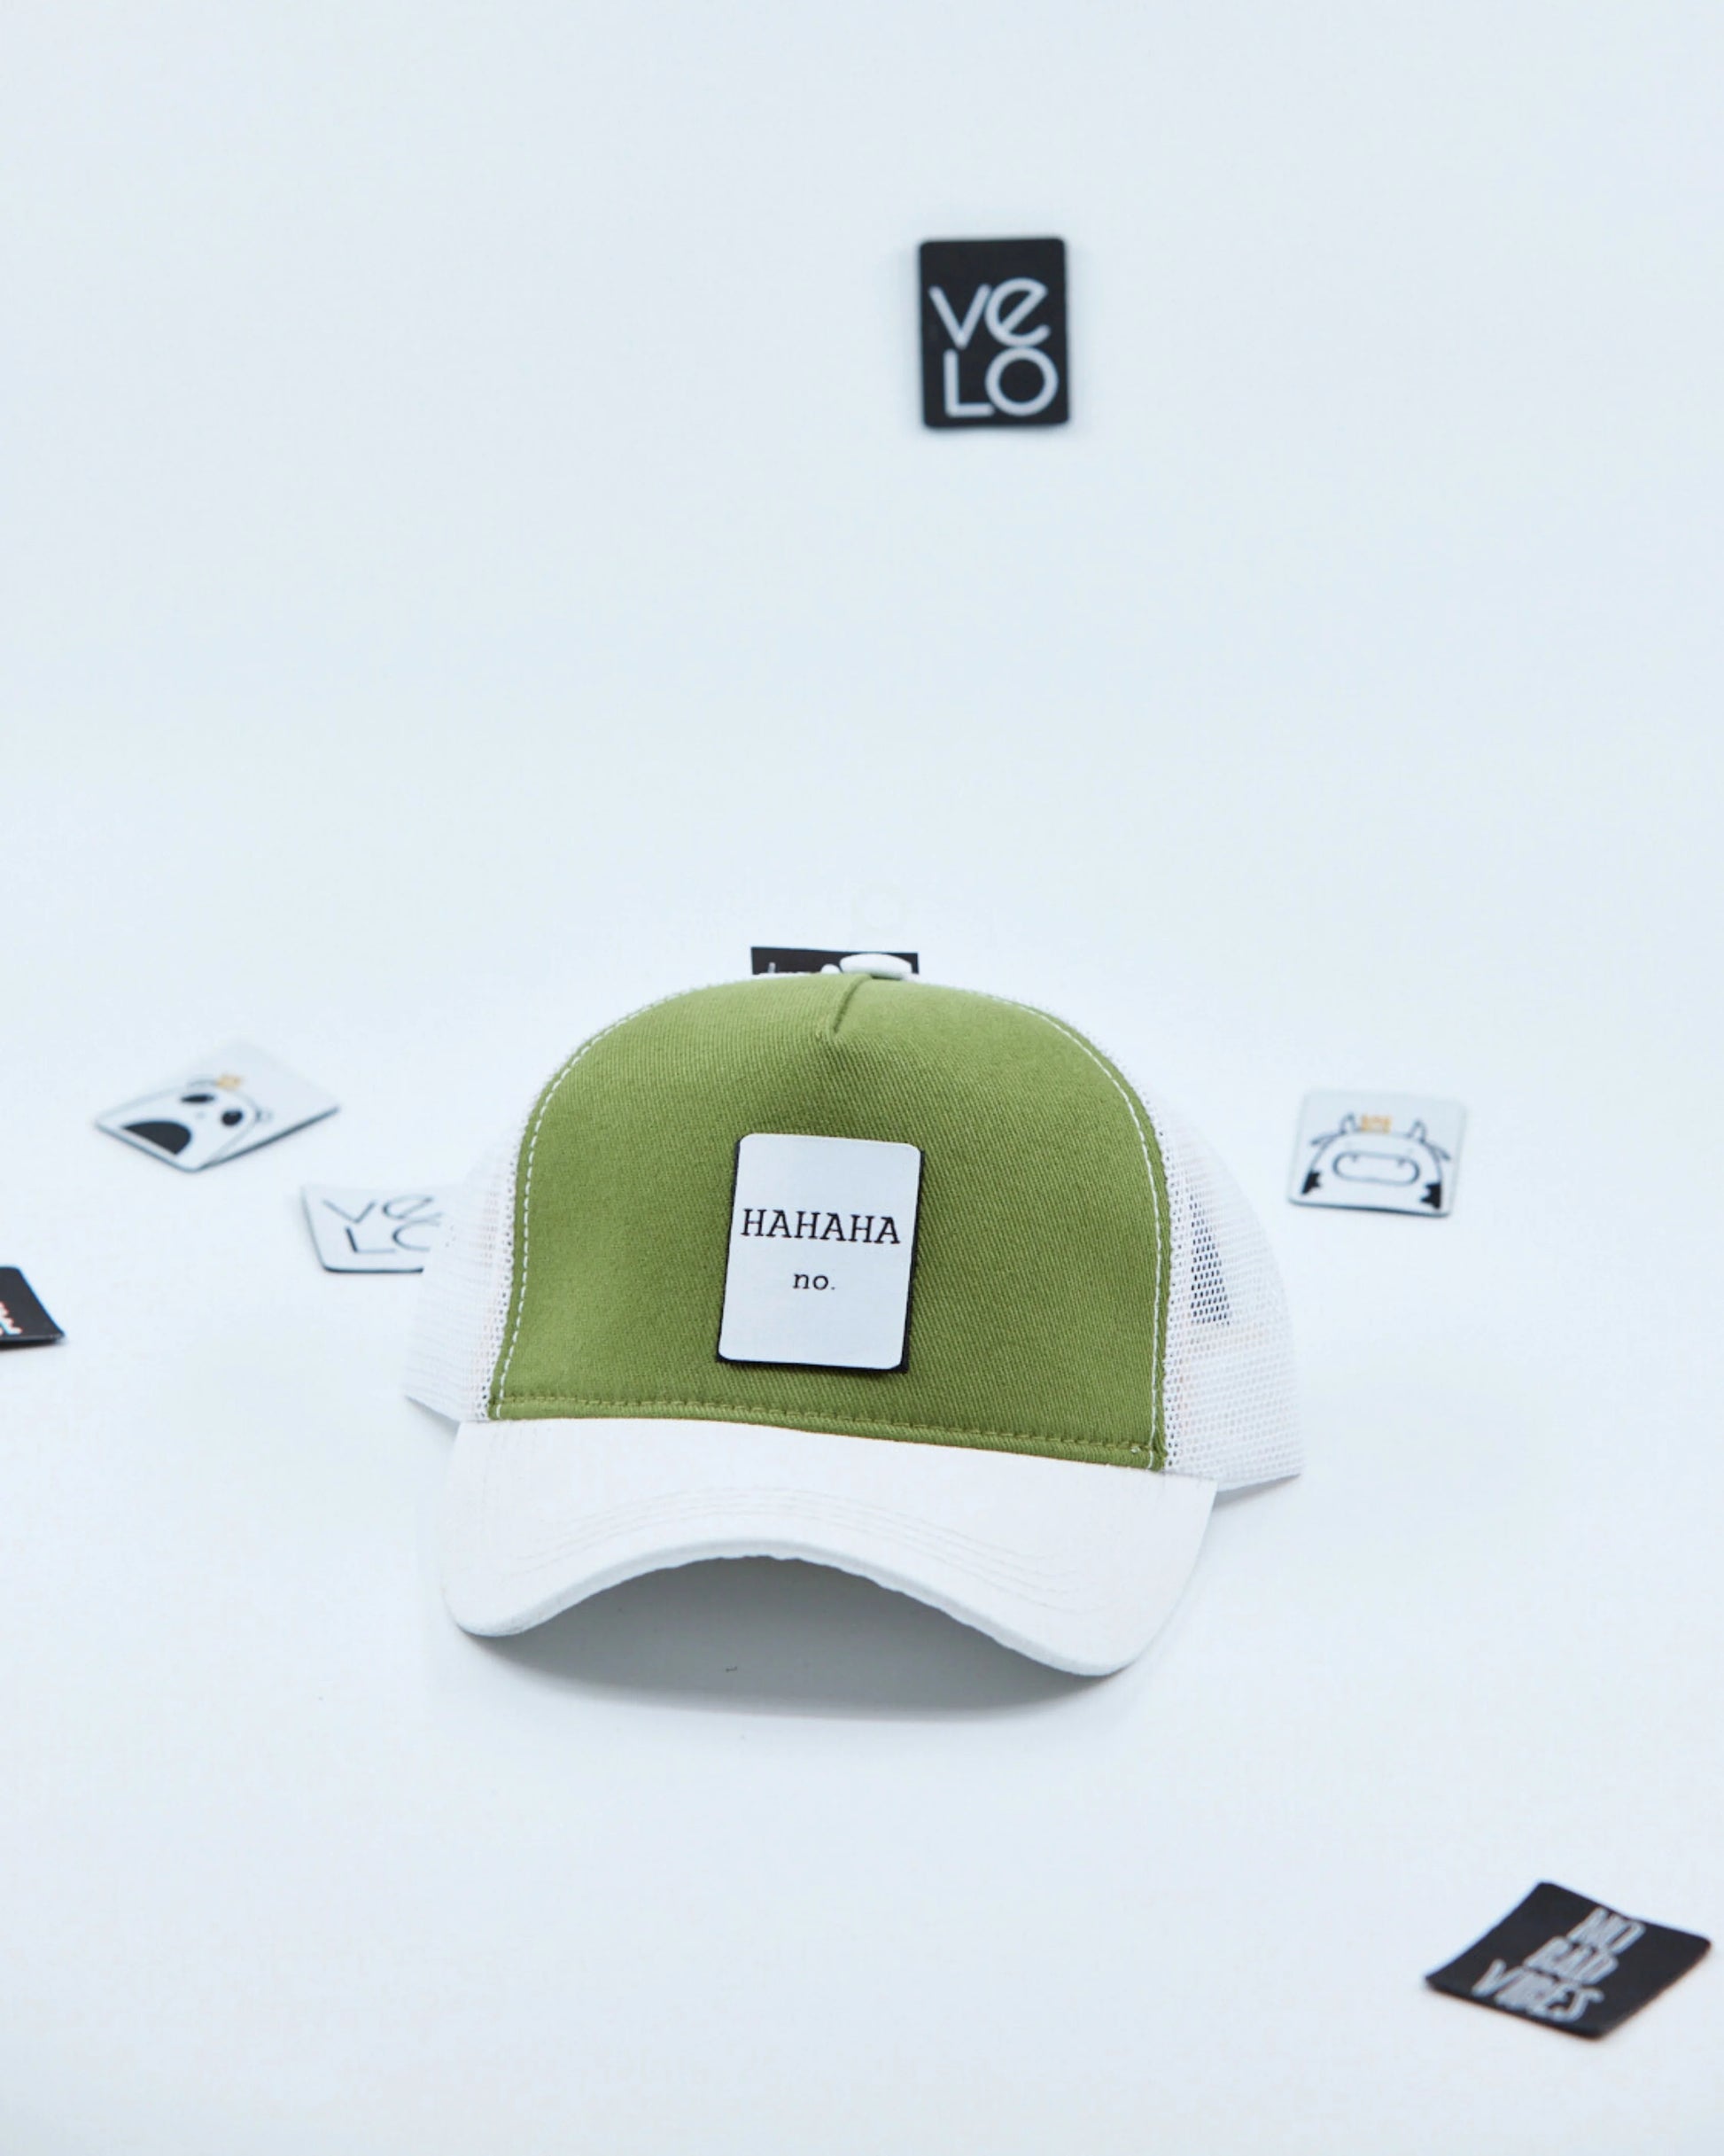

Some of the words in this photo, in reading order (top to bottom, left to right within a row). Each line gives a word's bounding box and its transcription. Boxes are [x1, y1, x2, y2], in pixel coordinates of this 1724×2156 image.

[944, 346, 1059, 417] LO
[741, 1209, 900, 1244] HAHAHA
[792, 1273, 835, 1290] no.
[1566, 1906, 1646, 1955] NO
[1522, 1935, 1619, 1986] BAD
[1471, 1958, 1605, 2022] VIBES
